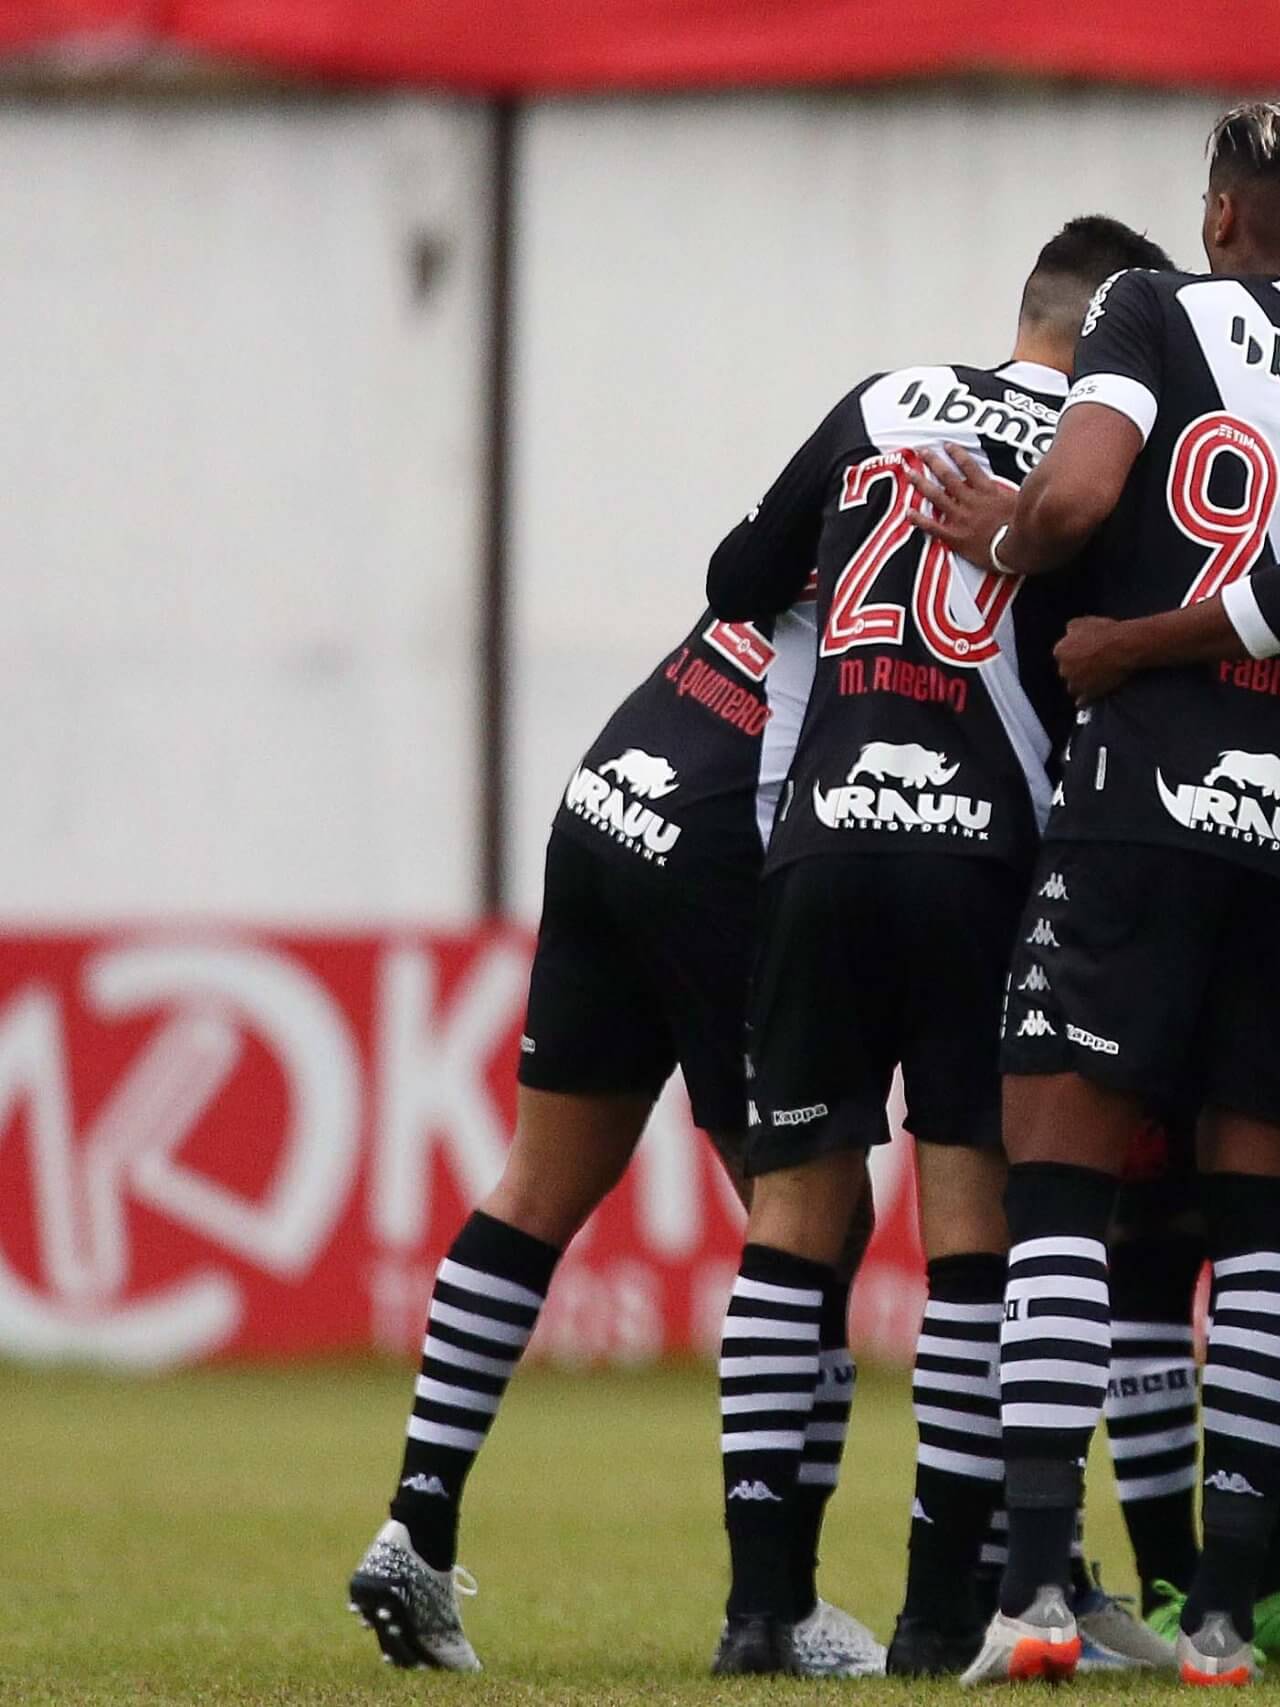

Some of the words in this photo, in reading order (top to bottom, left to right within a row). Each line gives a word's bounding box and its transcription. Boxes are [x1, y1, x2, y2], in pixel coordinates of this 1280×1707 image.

[1006, 390, 1061, 426] VASC
[820, 450, 1028, 668] 20
[1190, 819, 1266, 846] ENERGY
[773, 1103, 829, 1127] Kappa
